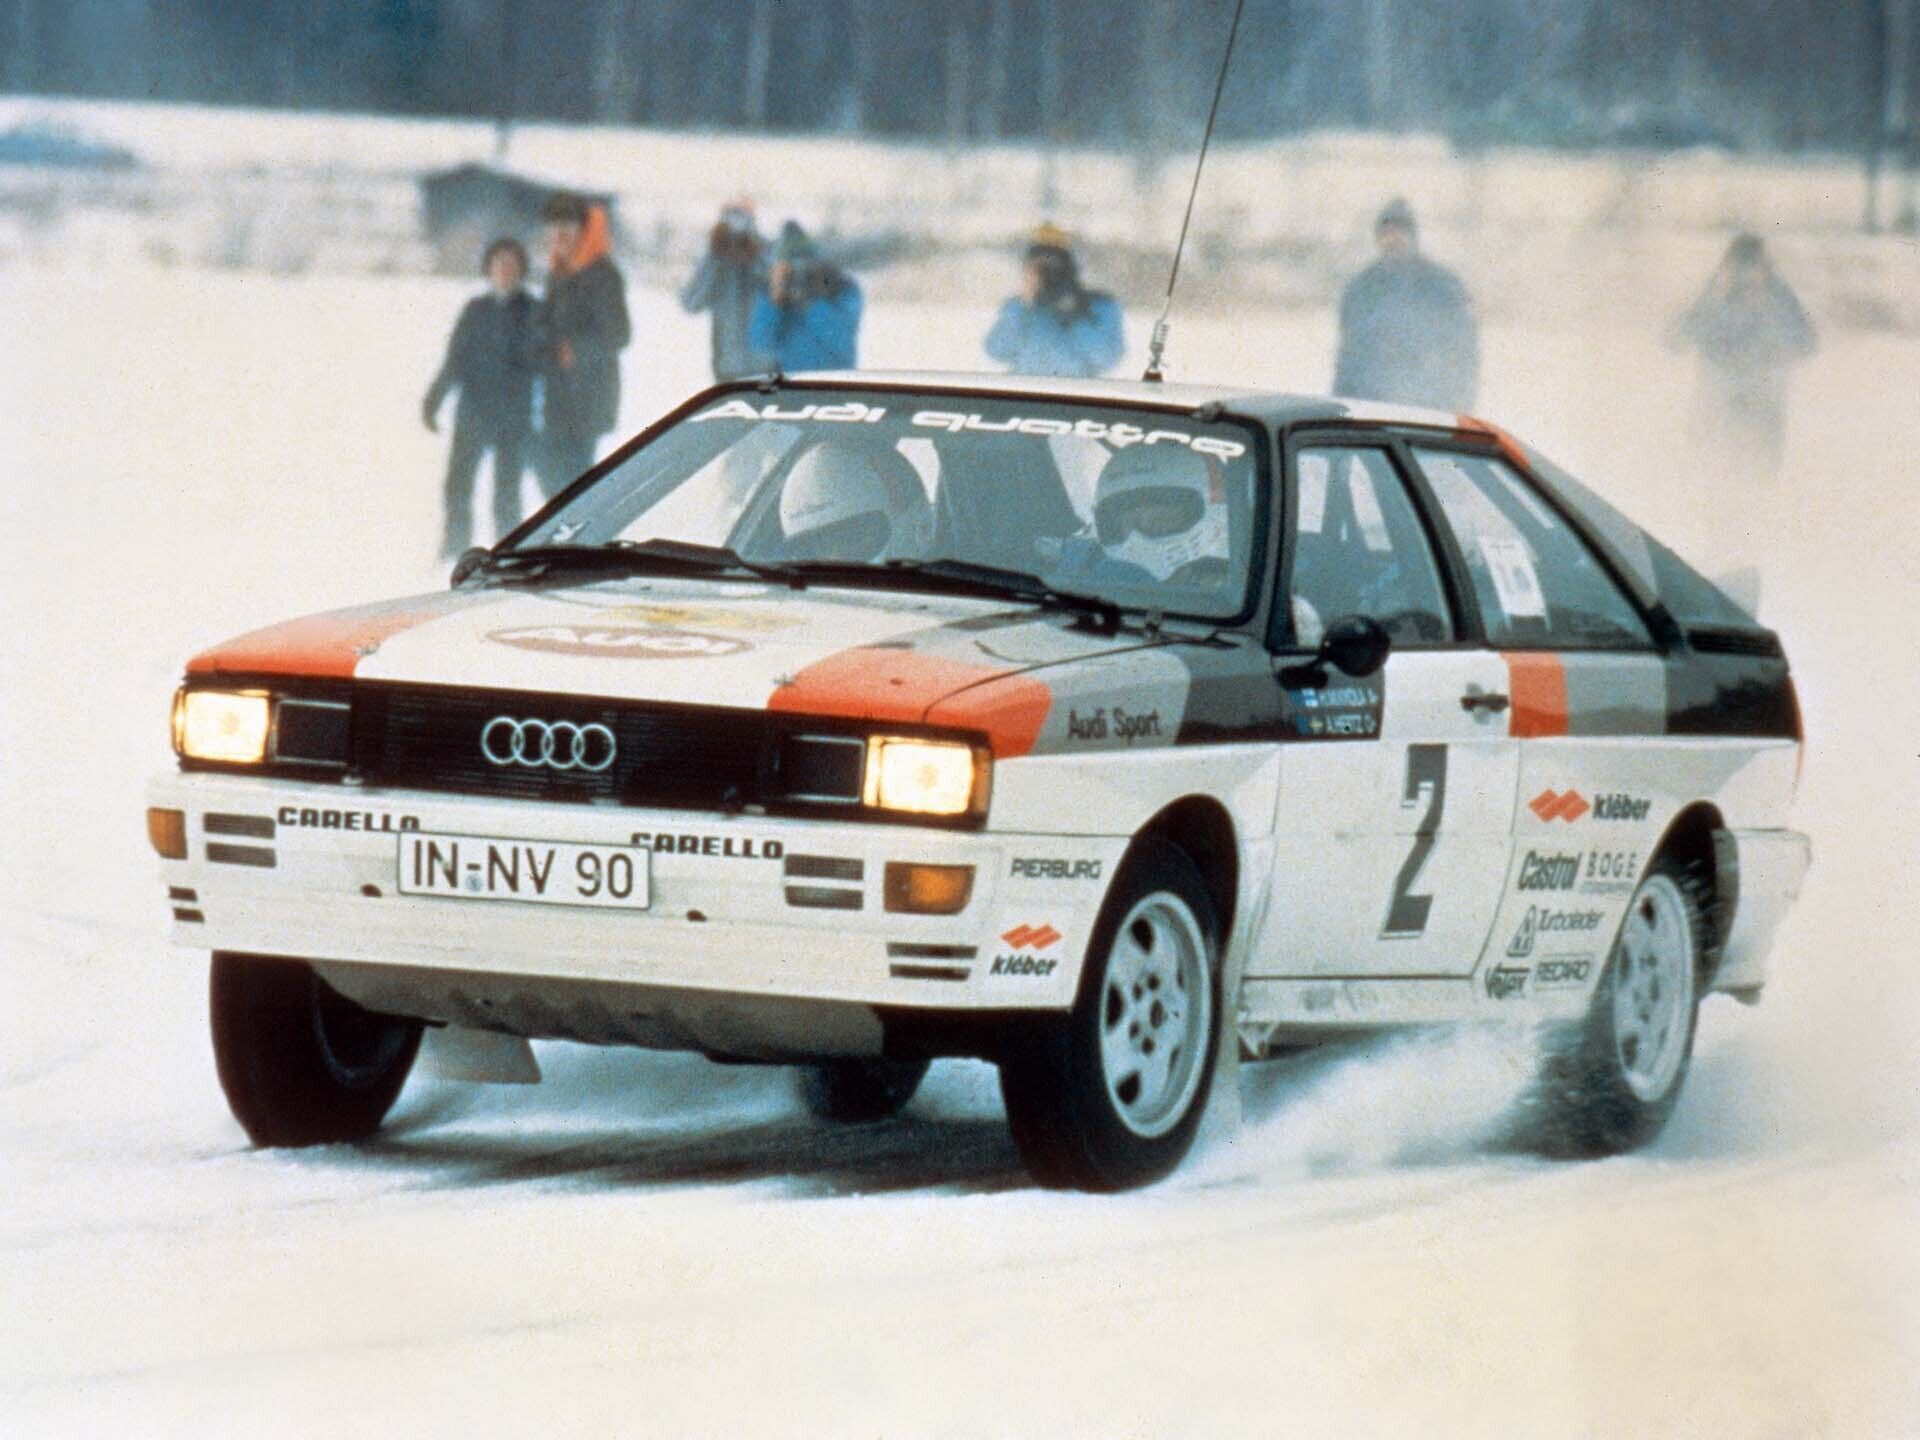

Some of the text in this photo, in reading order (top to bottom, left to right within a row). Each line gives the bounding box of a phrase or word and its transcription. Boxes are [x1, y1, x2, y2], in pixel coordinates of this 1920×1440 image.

[691, 399, 1246, 463] Audi quattro
[1067, 707, 1162, 743] Audi Sport
[277, 806, 421, 833] CARELLO
[630, 832, 784, 860] CARELLO
[1382, 743, 1449, 937] 2
[414, 839, 634, 899] IN-NV 90
[1010, 858, 1103, 880] PIERBURG
[1517, 849, 1583, 890] Castrol
[1585, 851, 1639, 879] BOGE
